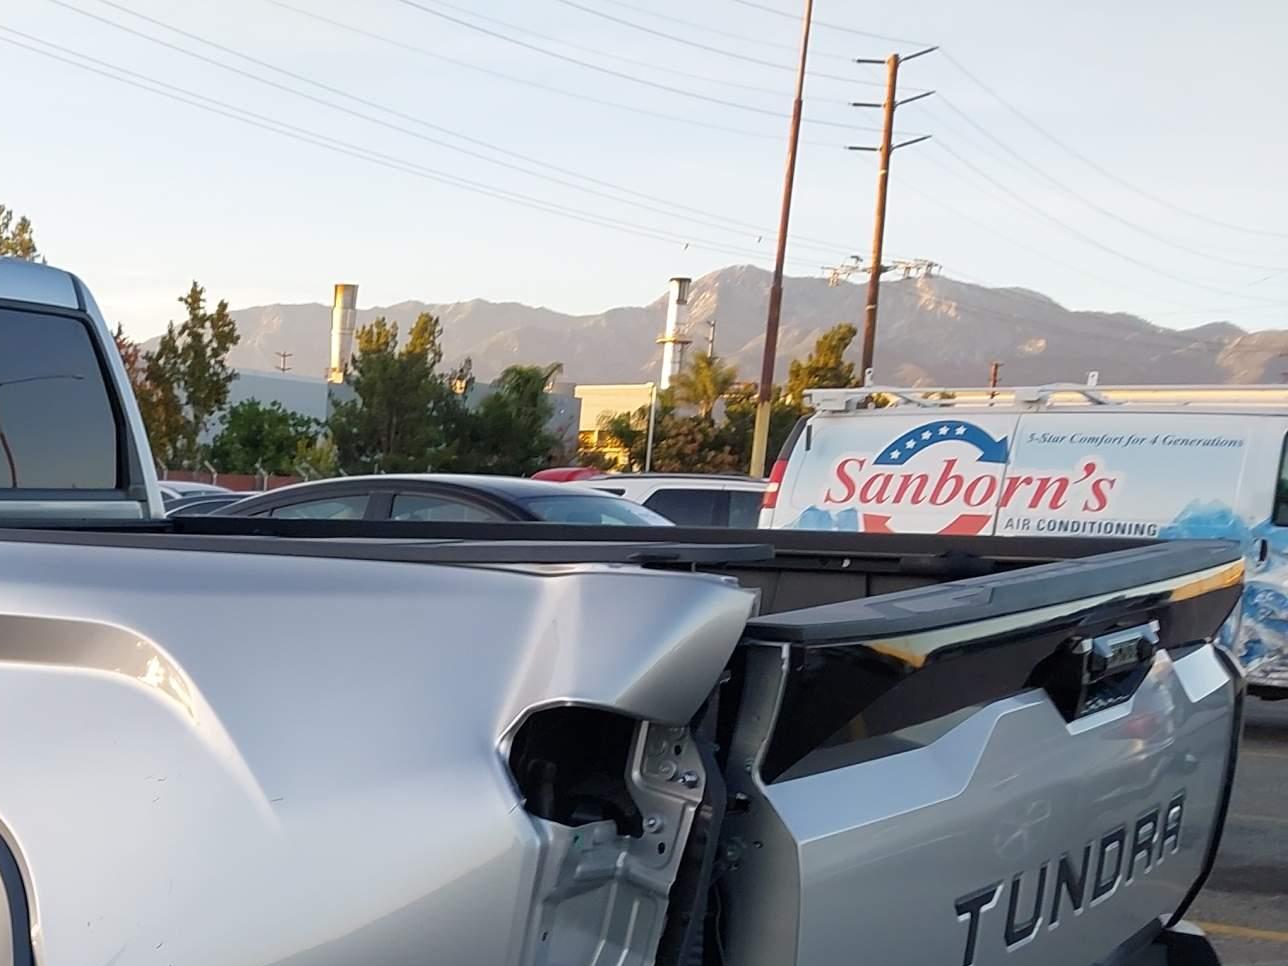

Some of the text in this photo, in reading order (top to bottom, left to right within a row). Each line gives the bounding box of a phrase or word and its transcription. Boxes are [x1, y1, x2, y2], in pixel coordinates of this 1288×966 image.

[1069, 433, 1124, 448] Comfort
[1122, 434, 1147, 448] for
[1149, 434, 1158, 446] 4
[1161, 434, 1244, 448] Generations
[823, 457, 1117, 513] Sanborn's
[1003, 518, 1158, 537] AIR CONDITIONING
